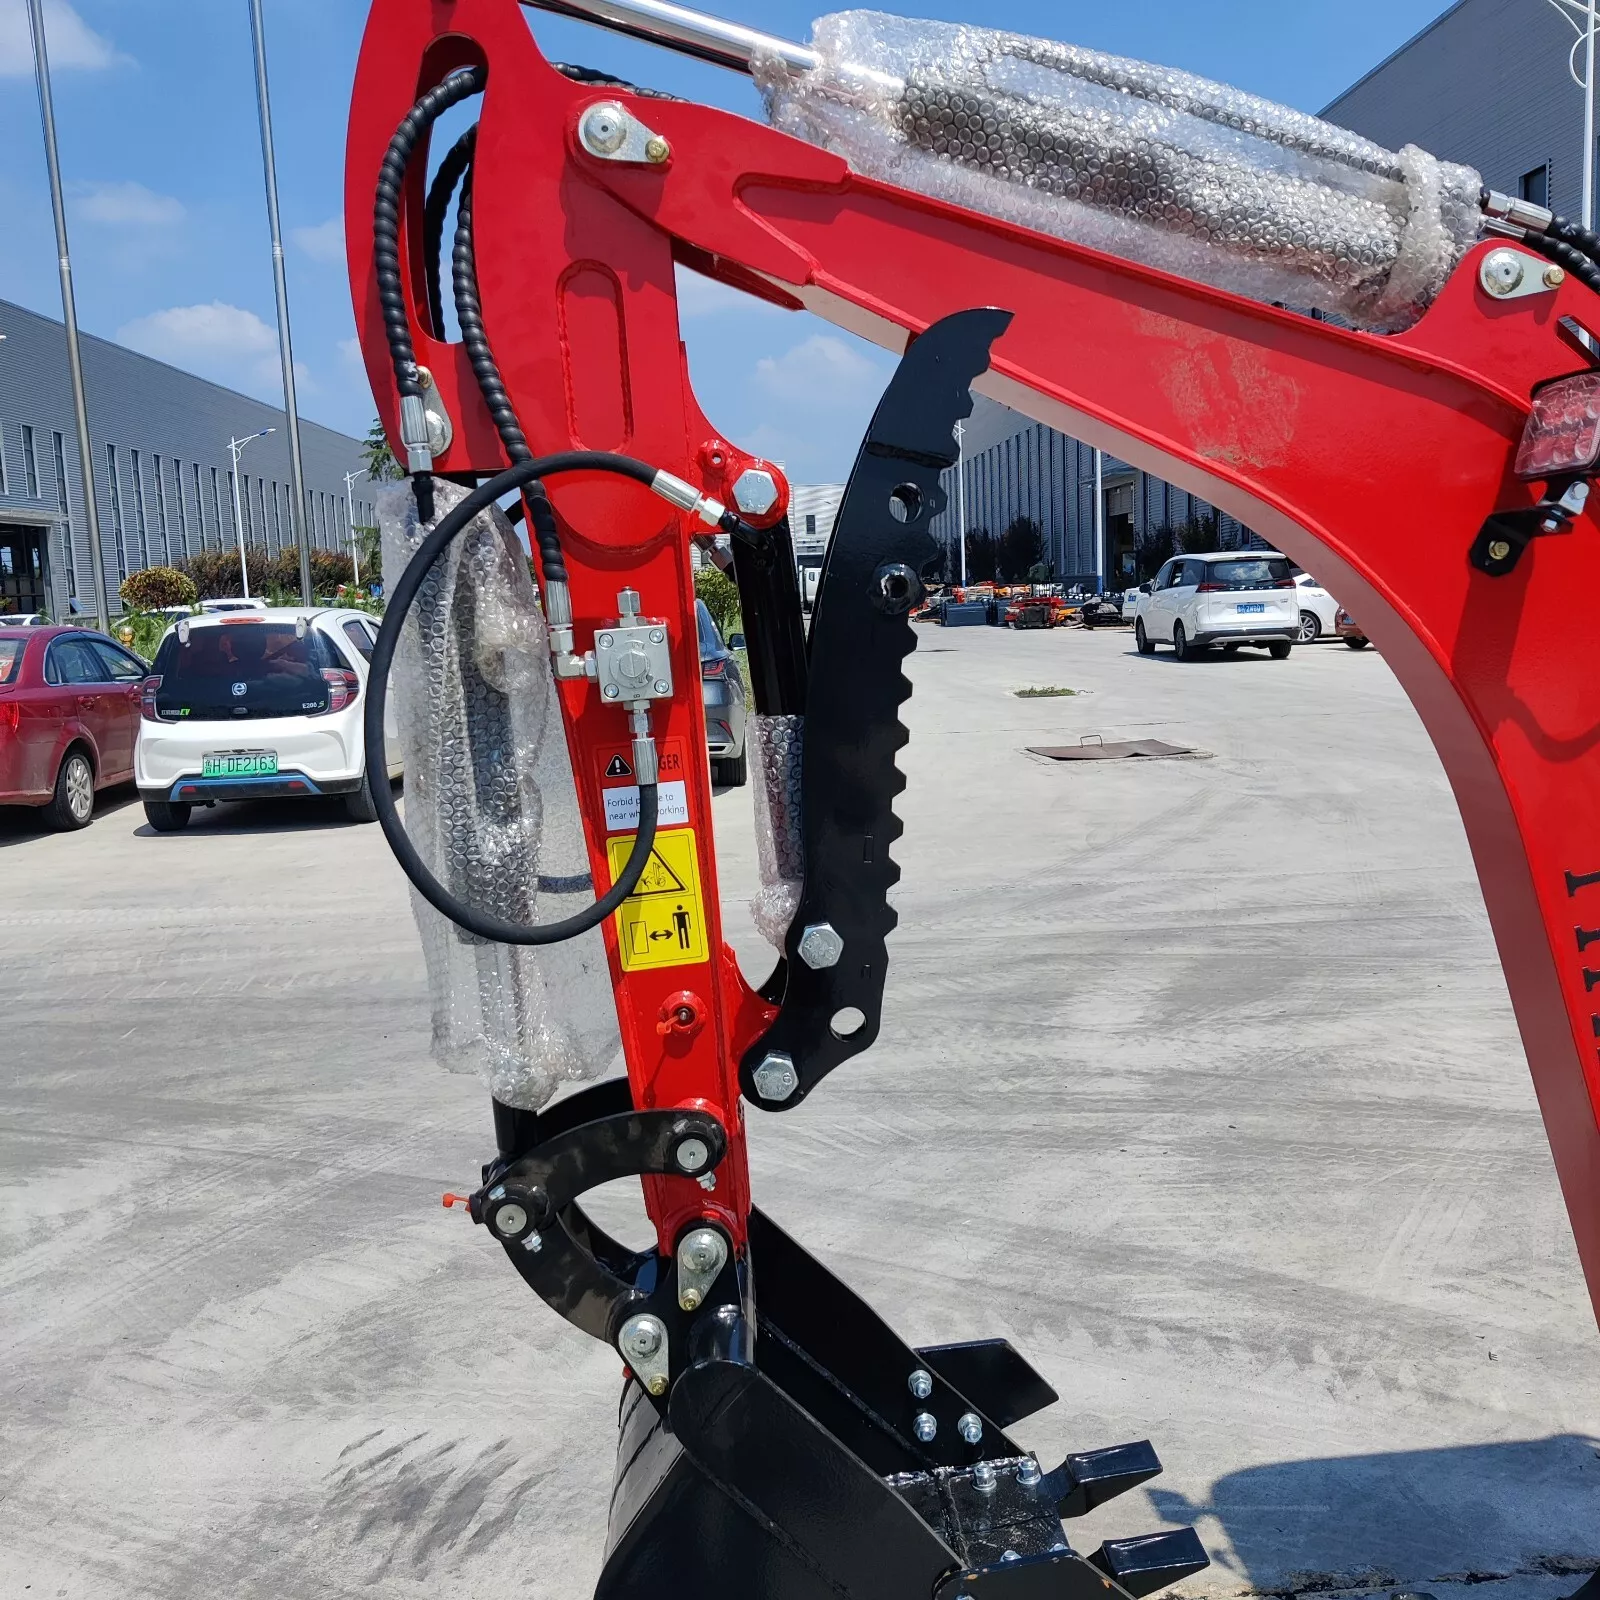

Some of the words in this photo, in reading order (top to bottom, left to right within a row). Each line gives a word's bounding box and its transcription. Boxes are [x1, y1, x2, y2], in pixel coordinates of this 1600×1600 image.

[607, 797, 633, 808] Forbid
[609, 812, 626, 821] near
[658, 805, 685, 815] orking
